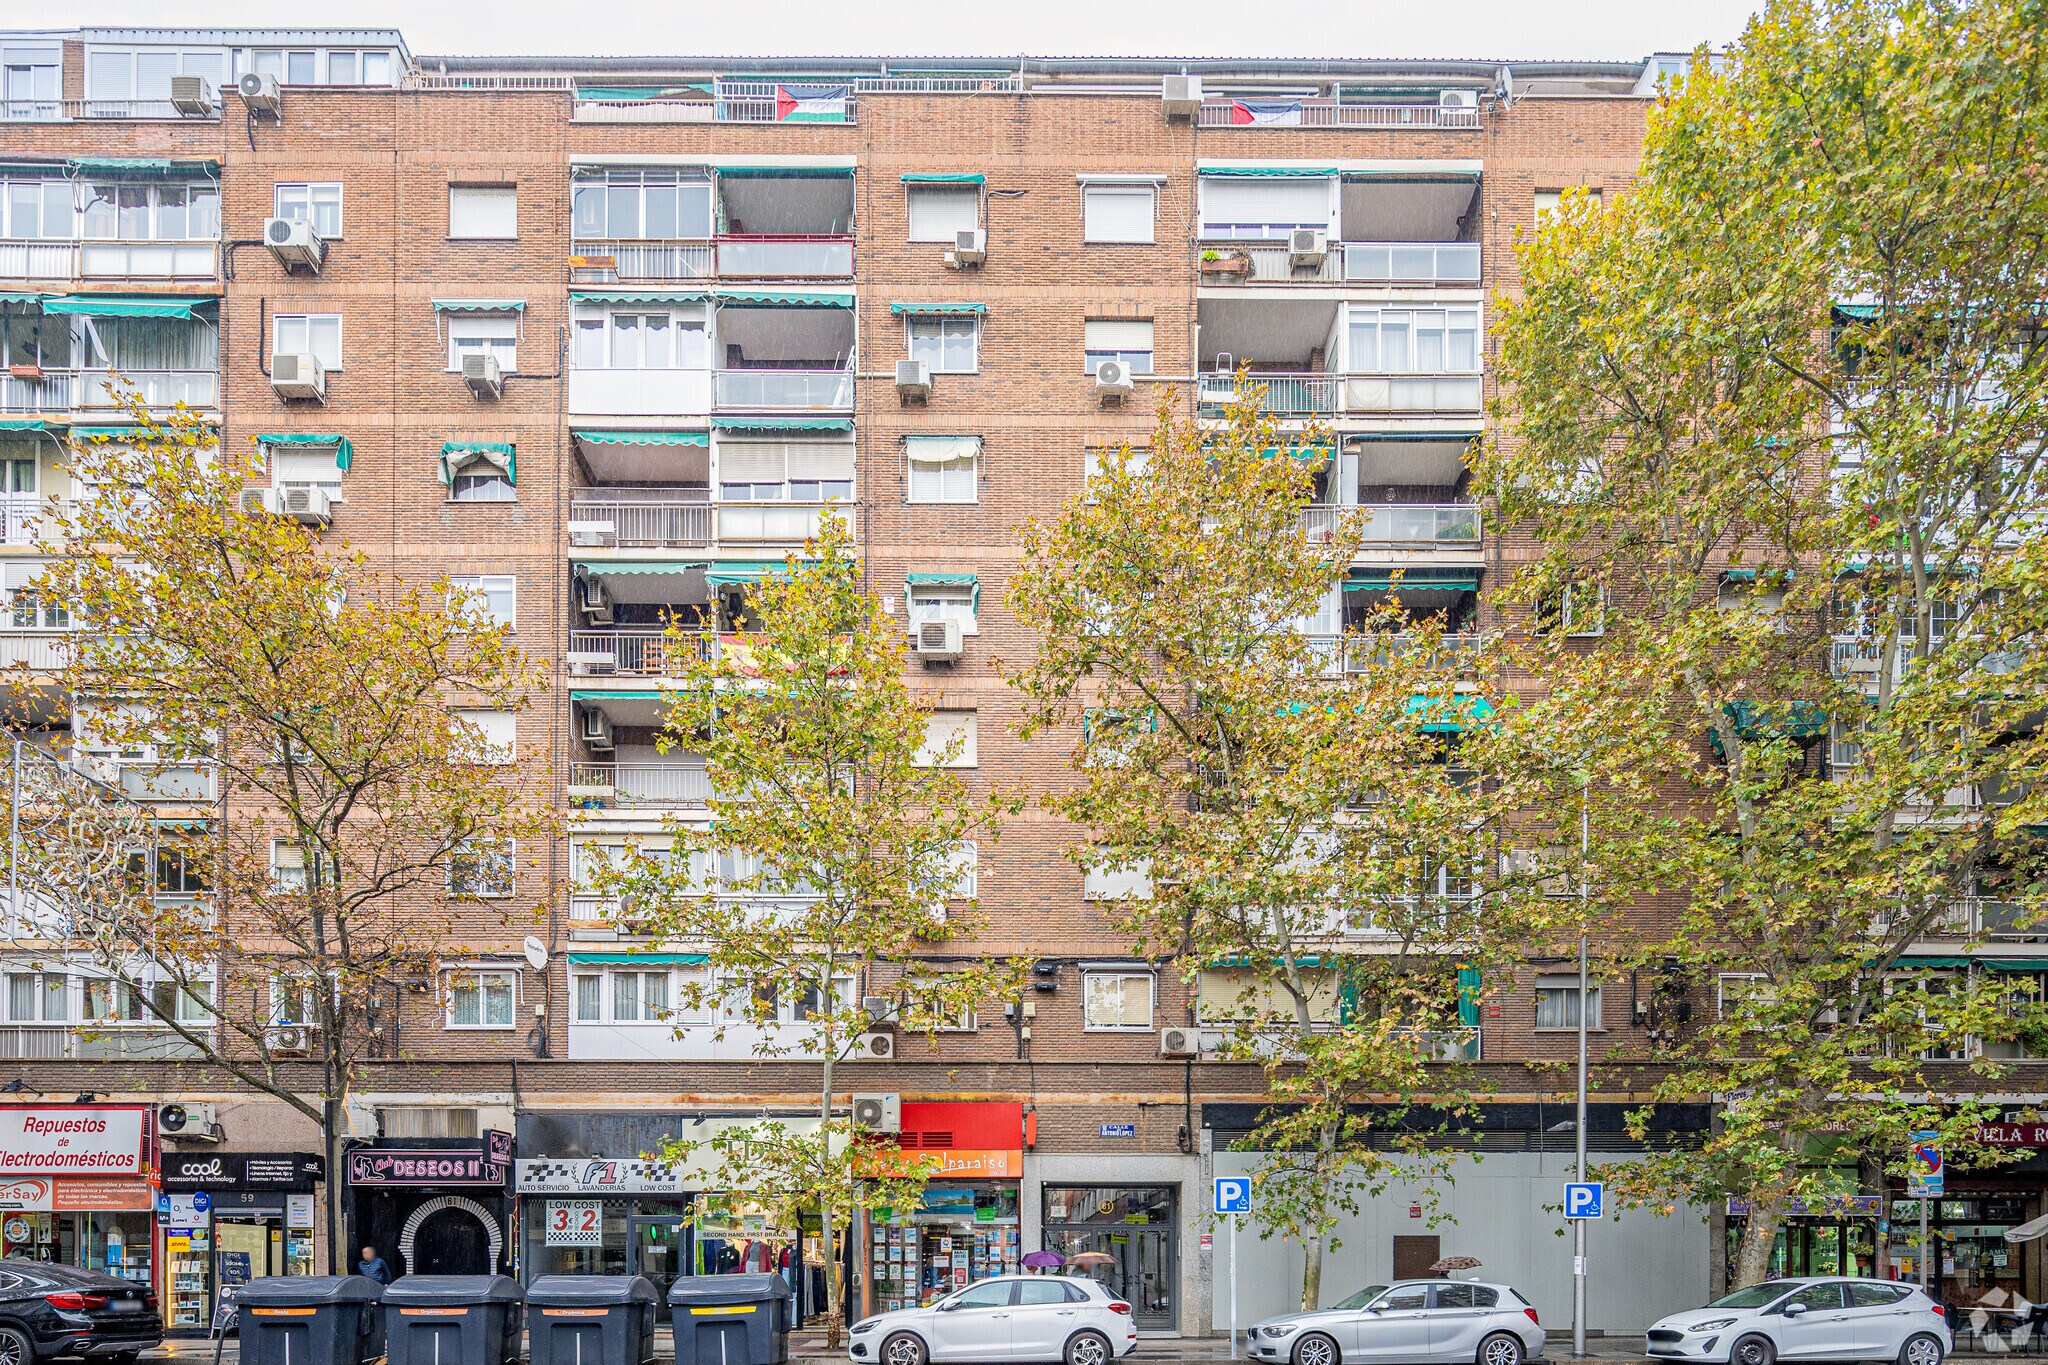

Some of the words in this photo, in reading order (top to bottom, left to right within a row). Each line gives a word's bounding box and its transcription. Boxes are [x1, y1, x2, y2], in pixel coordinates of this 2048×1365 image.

[23, 1116, 107, 1137] Repuestos
[2034, 1127, 2048, 1142] R
[57, 1137, 70, 1147] de
[0, 1150, 135, 1167] lectrodomésticos
[181, 1158, 223, 1176] cool
[374, 1155, 393, 1172] Club
[393, 1159, 465, 1177] DESEOS
[205, 1175, 236, 1184] technology
[582, 1161, 617, 1184] F1
[241, 1194, 255, 1203] 59
[447, 1197, 456, 1205] 61
[1219, 1181, 1242, 1210] P
[1570, 1187, 1593, 1215] P
[549, 1201, 571, 1209] LOW
[574, 1201, 600, 1209] COST
